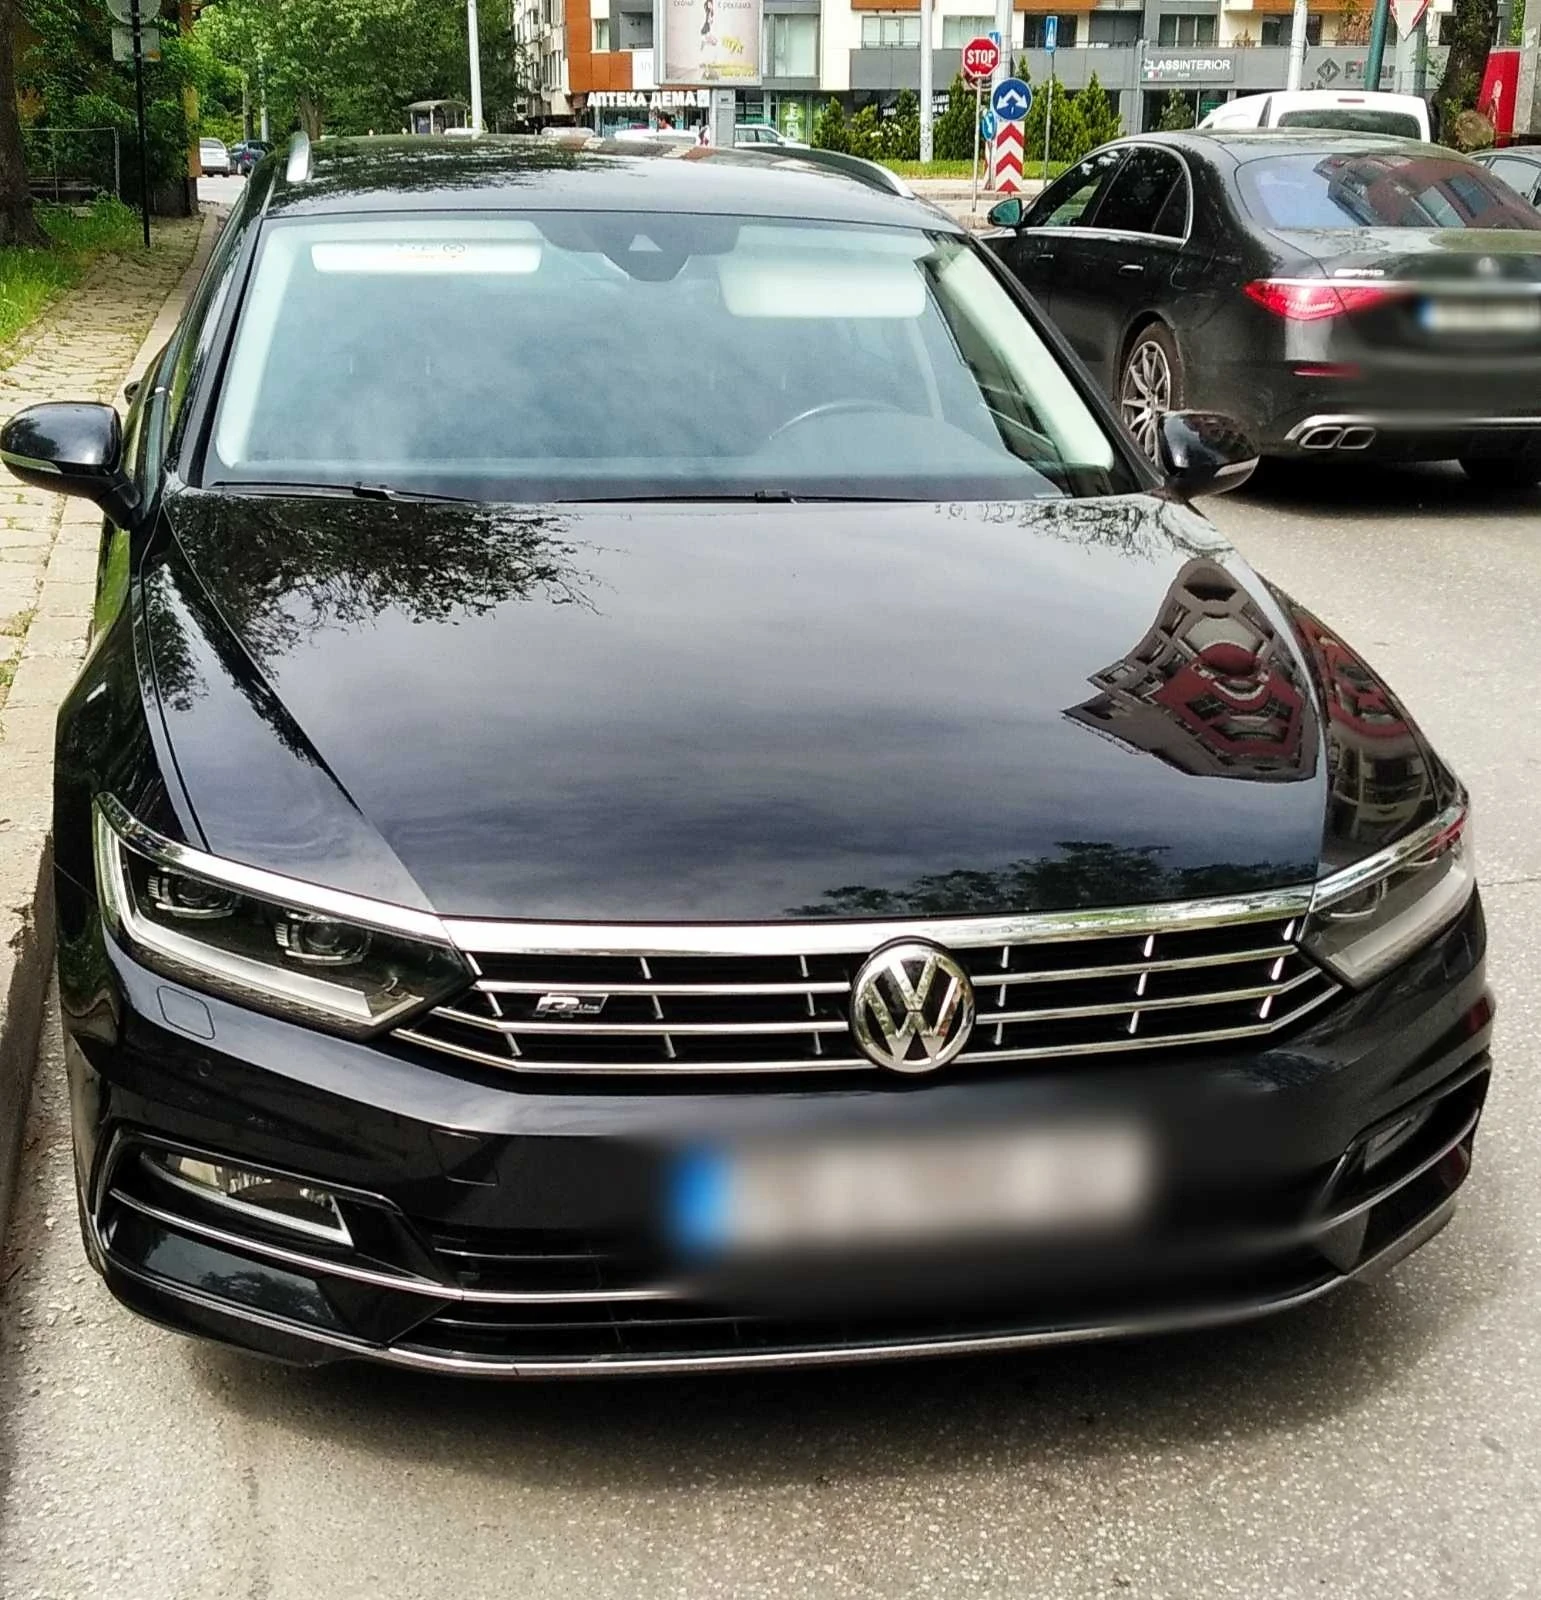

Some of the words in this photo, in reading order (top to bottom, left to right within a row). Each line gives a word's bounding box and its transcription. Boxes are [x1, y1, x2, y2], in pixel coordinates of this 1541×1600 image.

[967, 49, 996, 65] STOP
[586, 91, 647, 107] АПТЕКА
[649, 91, 697, 110] ДЕМА
